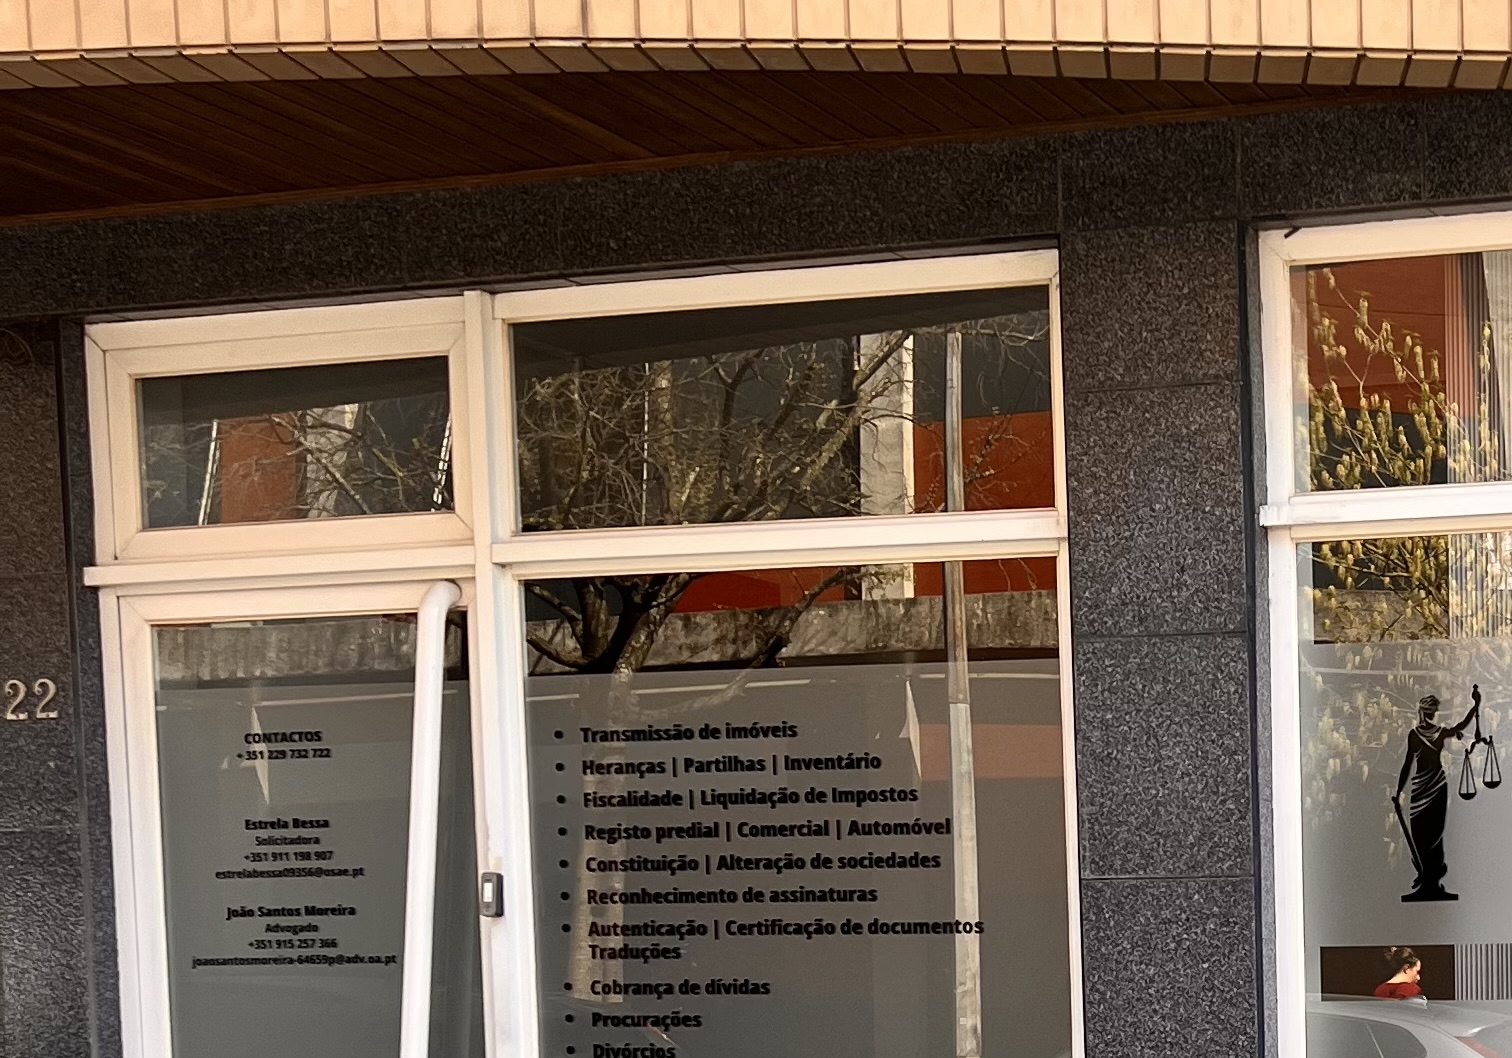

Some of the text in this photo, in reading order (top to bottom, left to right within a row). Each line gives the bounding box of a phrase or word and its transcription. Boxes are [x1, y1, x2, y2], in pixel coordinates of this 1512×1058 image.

[5, 678, 59, 720] 22
[244, 731, 322, 744] CONTACTOS
[580, 721, 798, 742] Transmissão de imóveis
[582, 760, 666, 778] Heranças
[684, 756, 766, 773] Partilhas
[784, 752, 882, 771] Inventário
[583, 790, 683, 808] Fiscalidade
[700, 787, 800, 810] Liquidação
[804, 787, 828, 803] de
[832, 786, 918, 808] Impostos
[245, 818, 330, 830] Estrela Bessa
[584, 823, 652, 844] Registo
[656, 822, 719, 844] predial
[737, 820, 830, 838] Comercial
[848, 818, 952, 836] Automóvel
[255, 835, 320, 847] Solicitadora
[272, 852, 290, 861] 911
[586, 855, 699, 876] Constituição
[716, 852, 806, 875] Alteração
[810, 853, 832, 870] de
[838, 851, 941, 869] sociedades
[587, 886, 878, 905] Reconhecimento de assinaturas
[226, 904, 356, 921] João Santos Moreira
[265, 922, 319, 935] Advogado
[588, 920, 708, 941] Autenticação
[725, 919, 836, 940] Certificação
[840, 918, 863, 934] de
[868, 918, 984, 934] documentos
[589, 943, 682, 964] Traduções
[590, 978, 770, 1000] Cobrança de dívidas
[591, 1012, 702, 1032] Procurações
